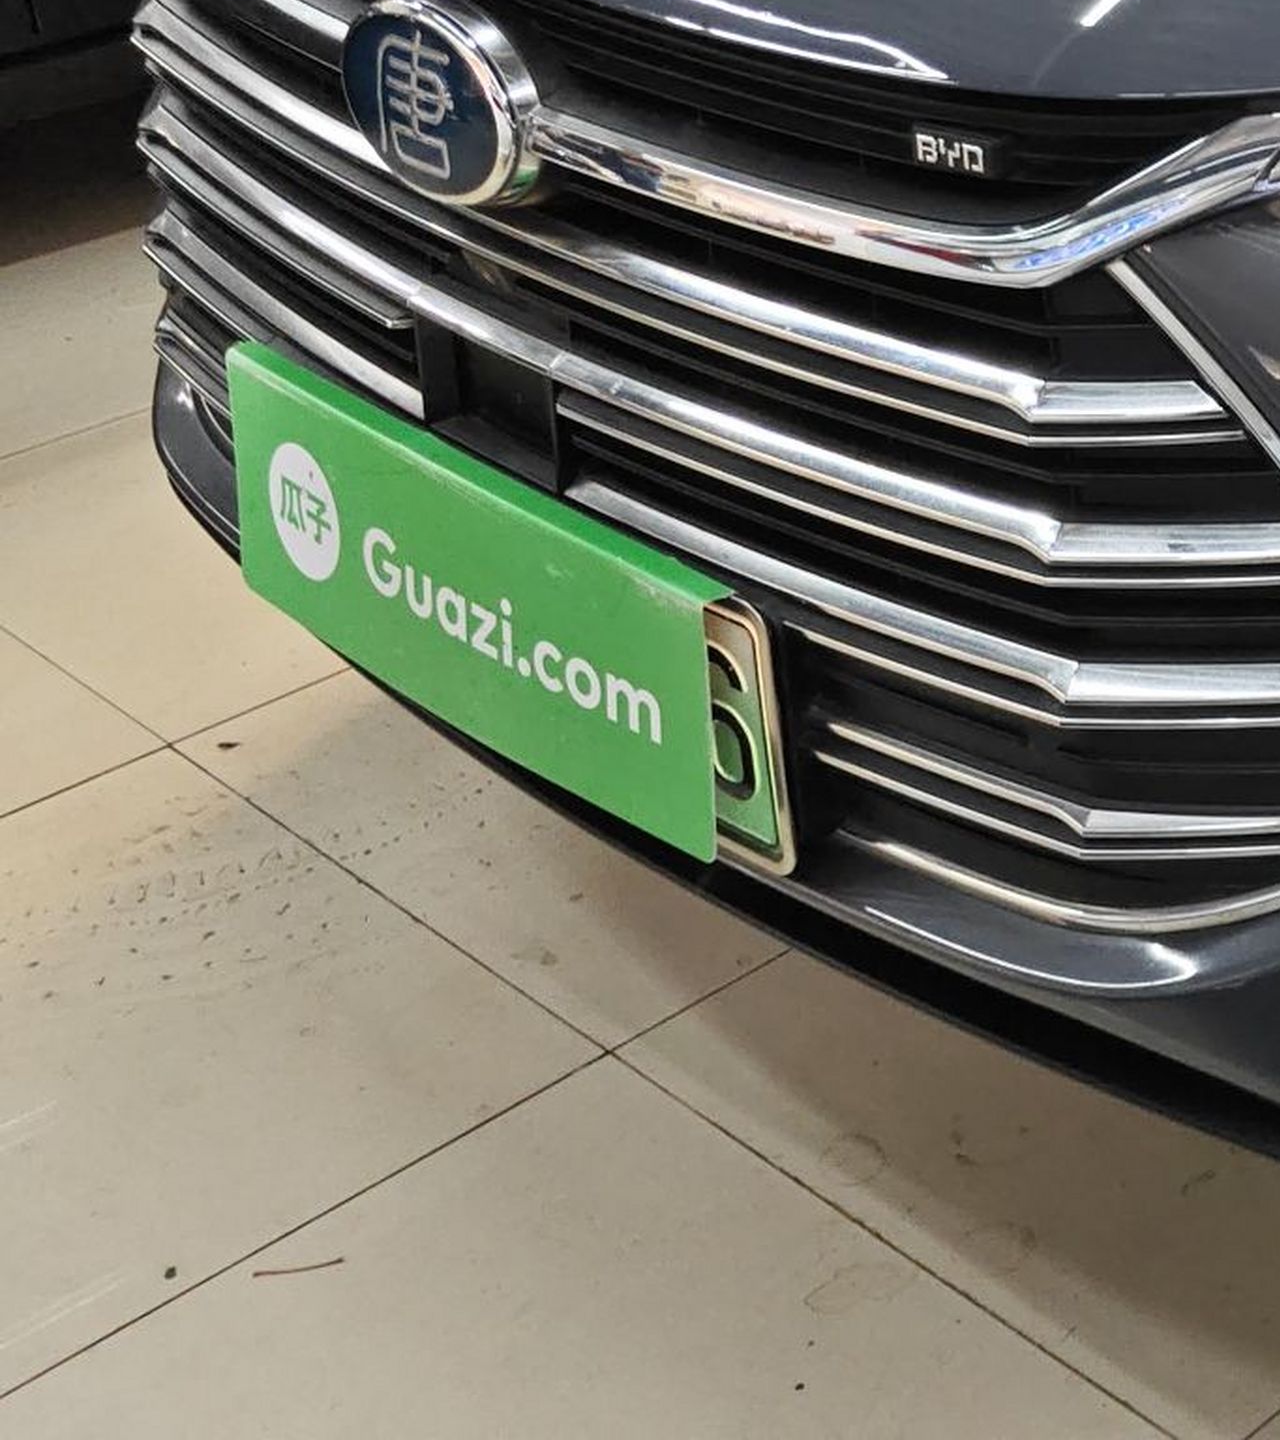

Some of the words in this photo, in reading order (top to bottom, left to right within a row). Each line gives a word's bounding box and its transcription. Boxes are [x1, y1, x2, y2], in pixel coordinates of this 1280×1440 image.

[915, 133, 985, 175] BYD
[280, 474, 332, 545] 瓜子
[362, 527, 662, 745] Guazi.com
